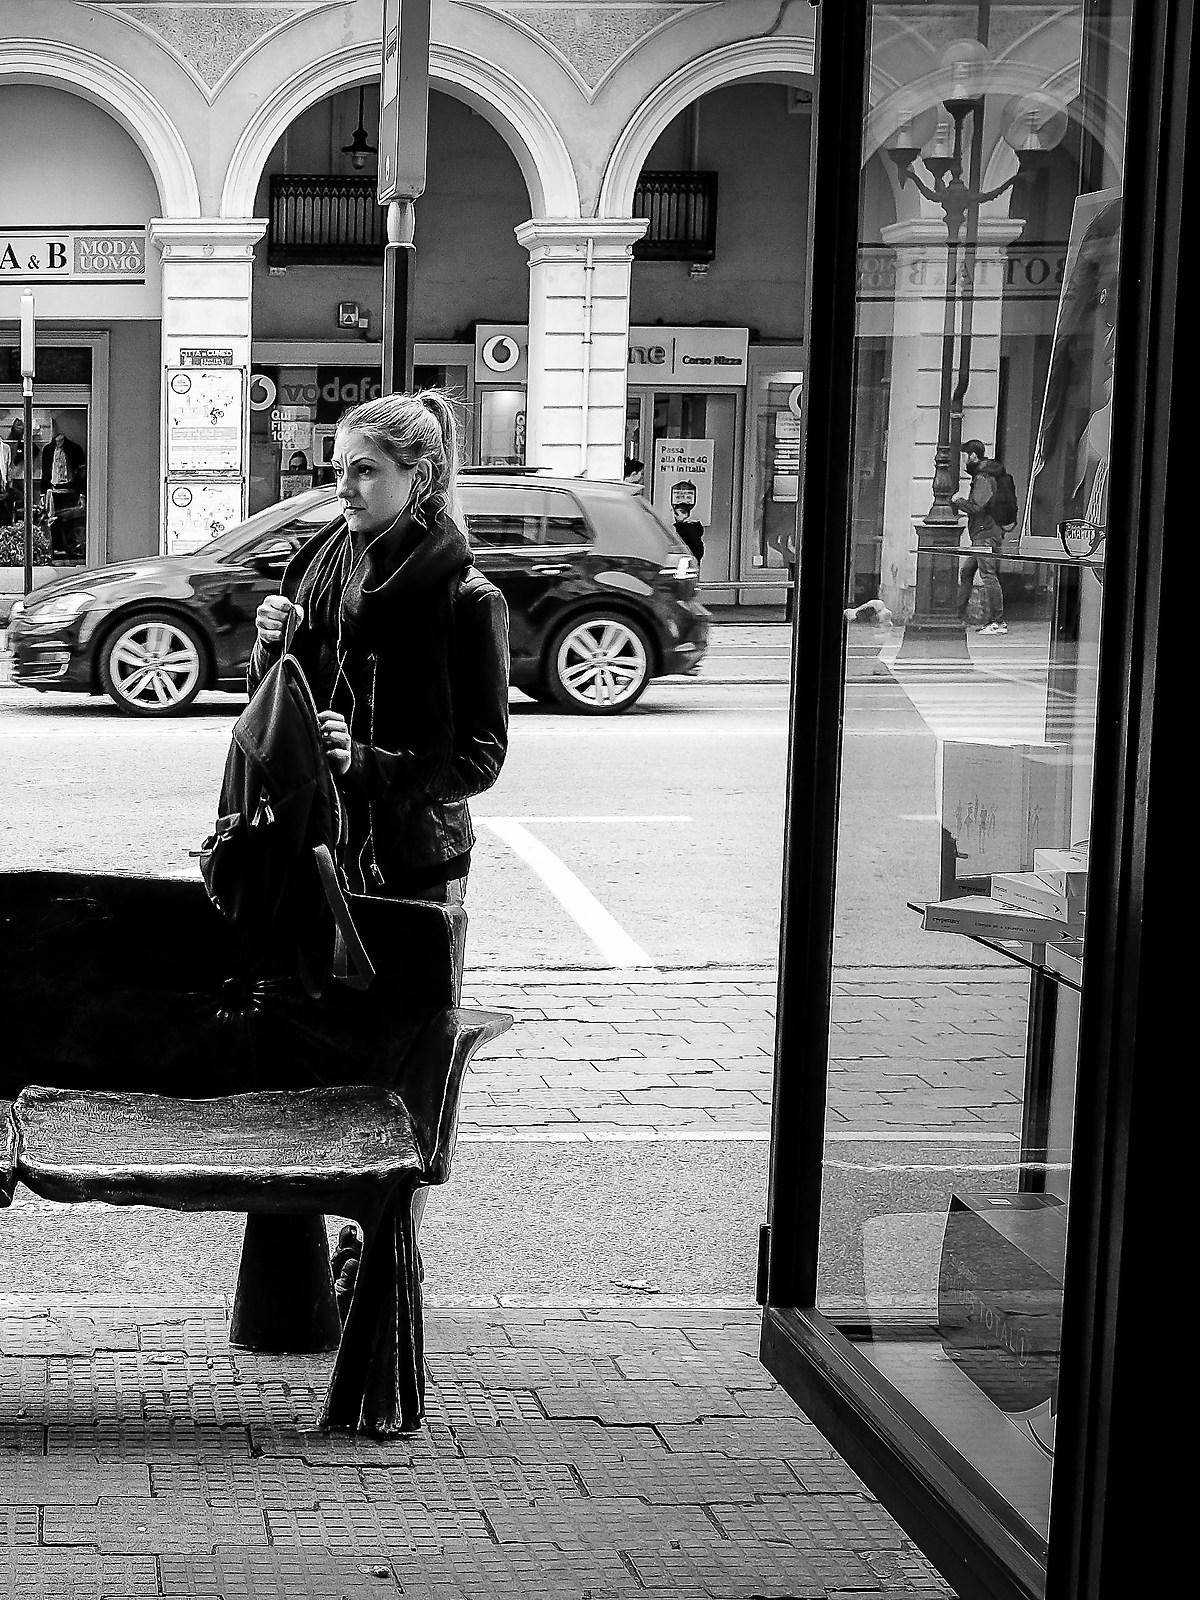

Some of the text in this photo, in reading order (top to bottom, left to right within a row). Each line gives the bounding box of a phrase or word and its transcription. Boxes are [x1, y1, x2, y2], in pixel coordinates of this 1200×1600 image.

[79, 240, 140, 256] MODA
[27, 255, 40, 269] &
[46, 242, 68, 269] B
[80, 255, 141, 270] UOMO
[682, 355, 712, 365] Corso
[714, 355, 743, 366] Nizza
[282, 376, 381, 402] vodafo
[661, 445, 685, 454] Passa
[660, 455, 708, 464] alla Rete 4G
[685, 465, 707, 473] Italia
